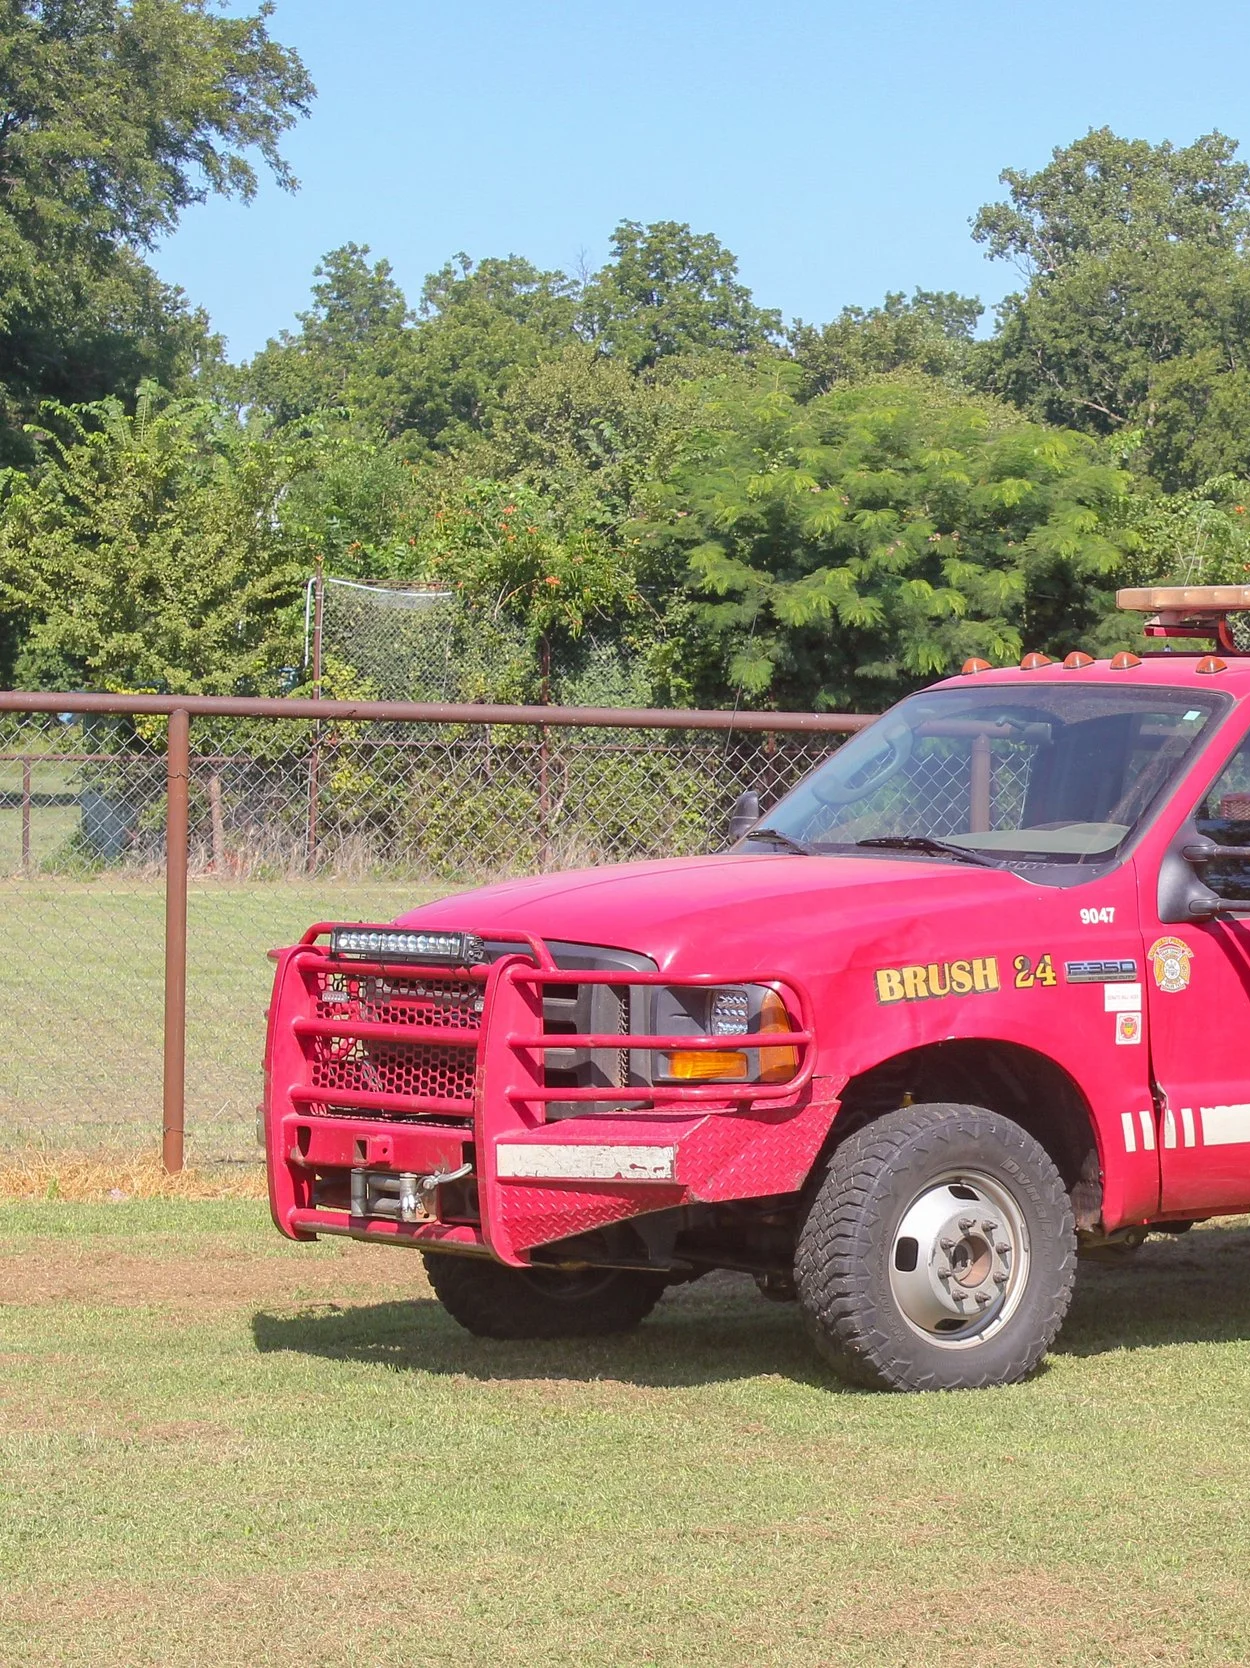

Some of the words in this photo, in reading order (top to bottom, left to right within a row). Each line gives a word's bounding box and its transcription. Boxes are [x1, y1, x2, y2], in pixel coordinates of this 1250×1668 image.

[1080, 907, 1115, 924] 9047
[1067, 961, 1136, 975] F-350
[876, 956, 1000, 1004] BRUSH
[1013, 954, 1057, 989] 24
